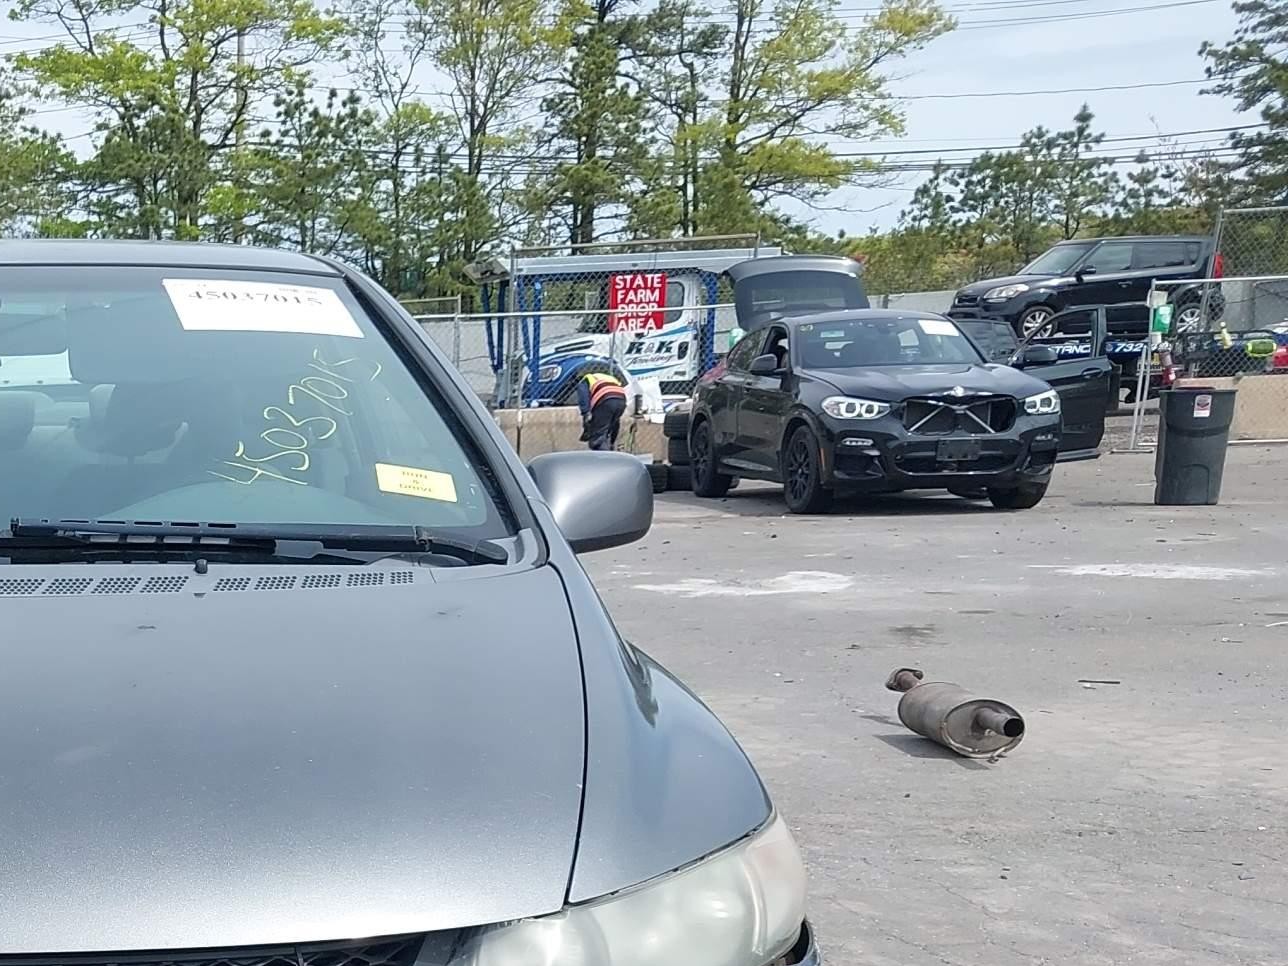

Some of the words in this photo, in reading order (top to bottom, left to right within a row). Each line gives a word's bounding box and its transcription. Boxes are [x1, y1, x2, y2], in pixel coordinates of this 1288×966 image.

[615, 274, 662, 288] STATE
[617, 289, 659, 303] FARM
[617, 303, 658, 317] DROP
[617, 318, 657, 332] AREA
